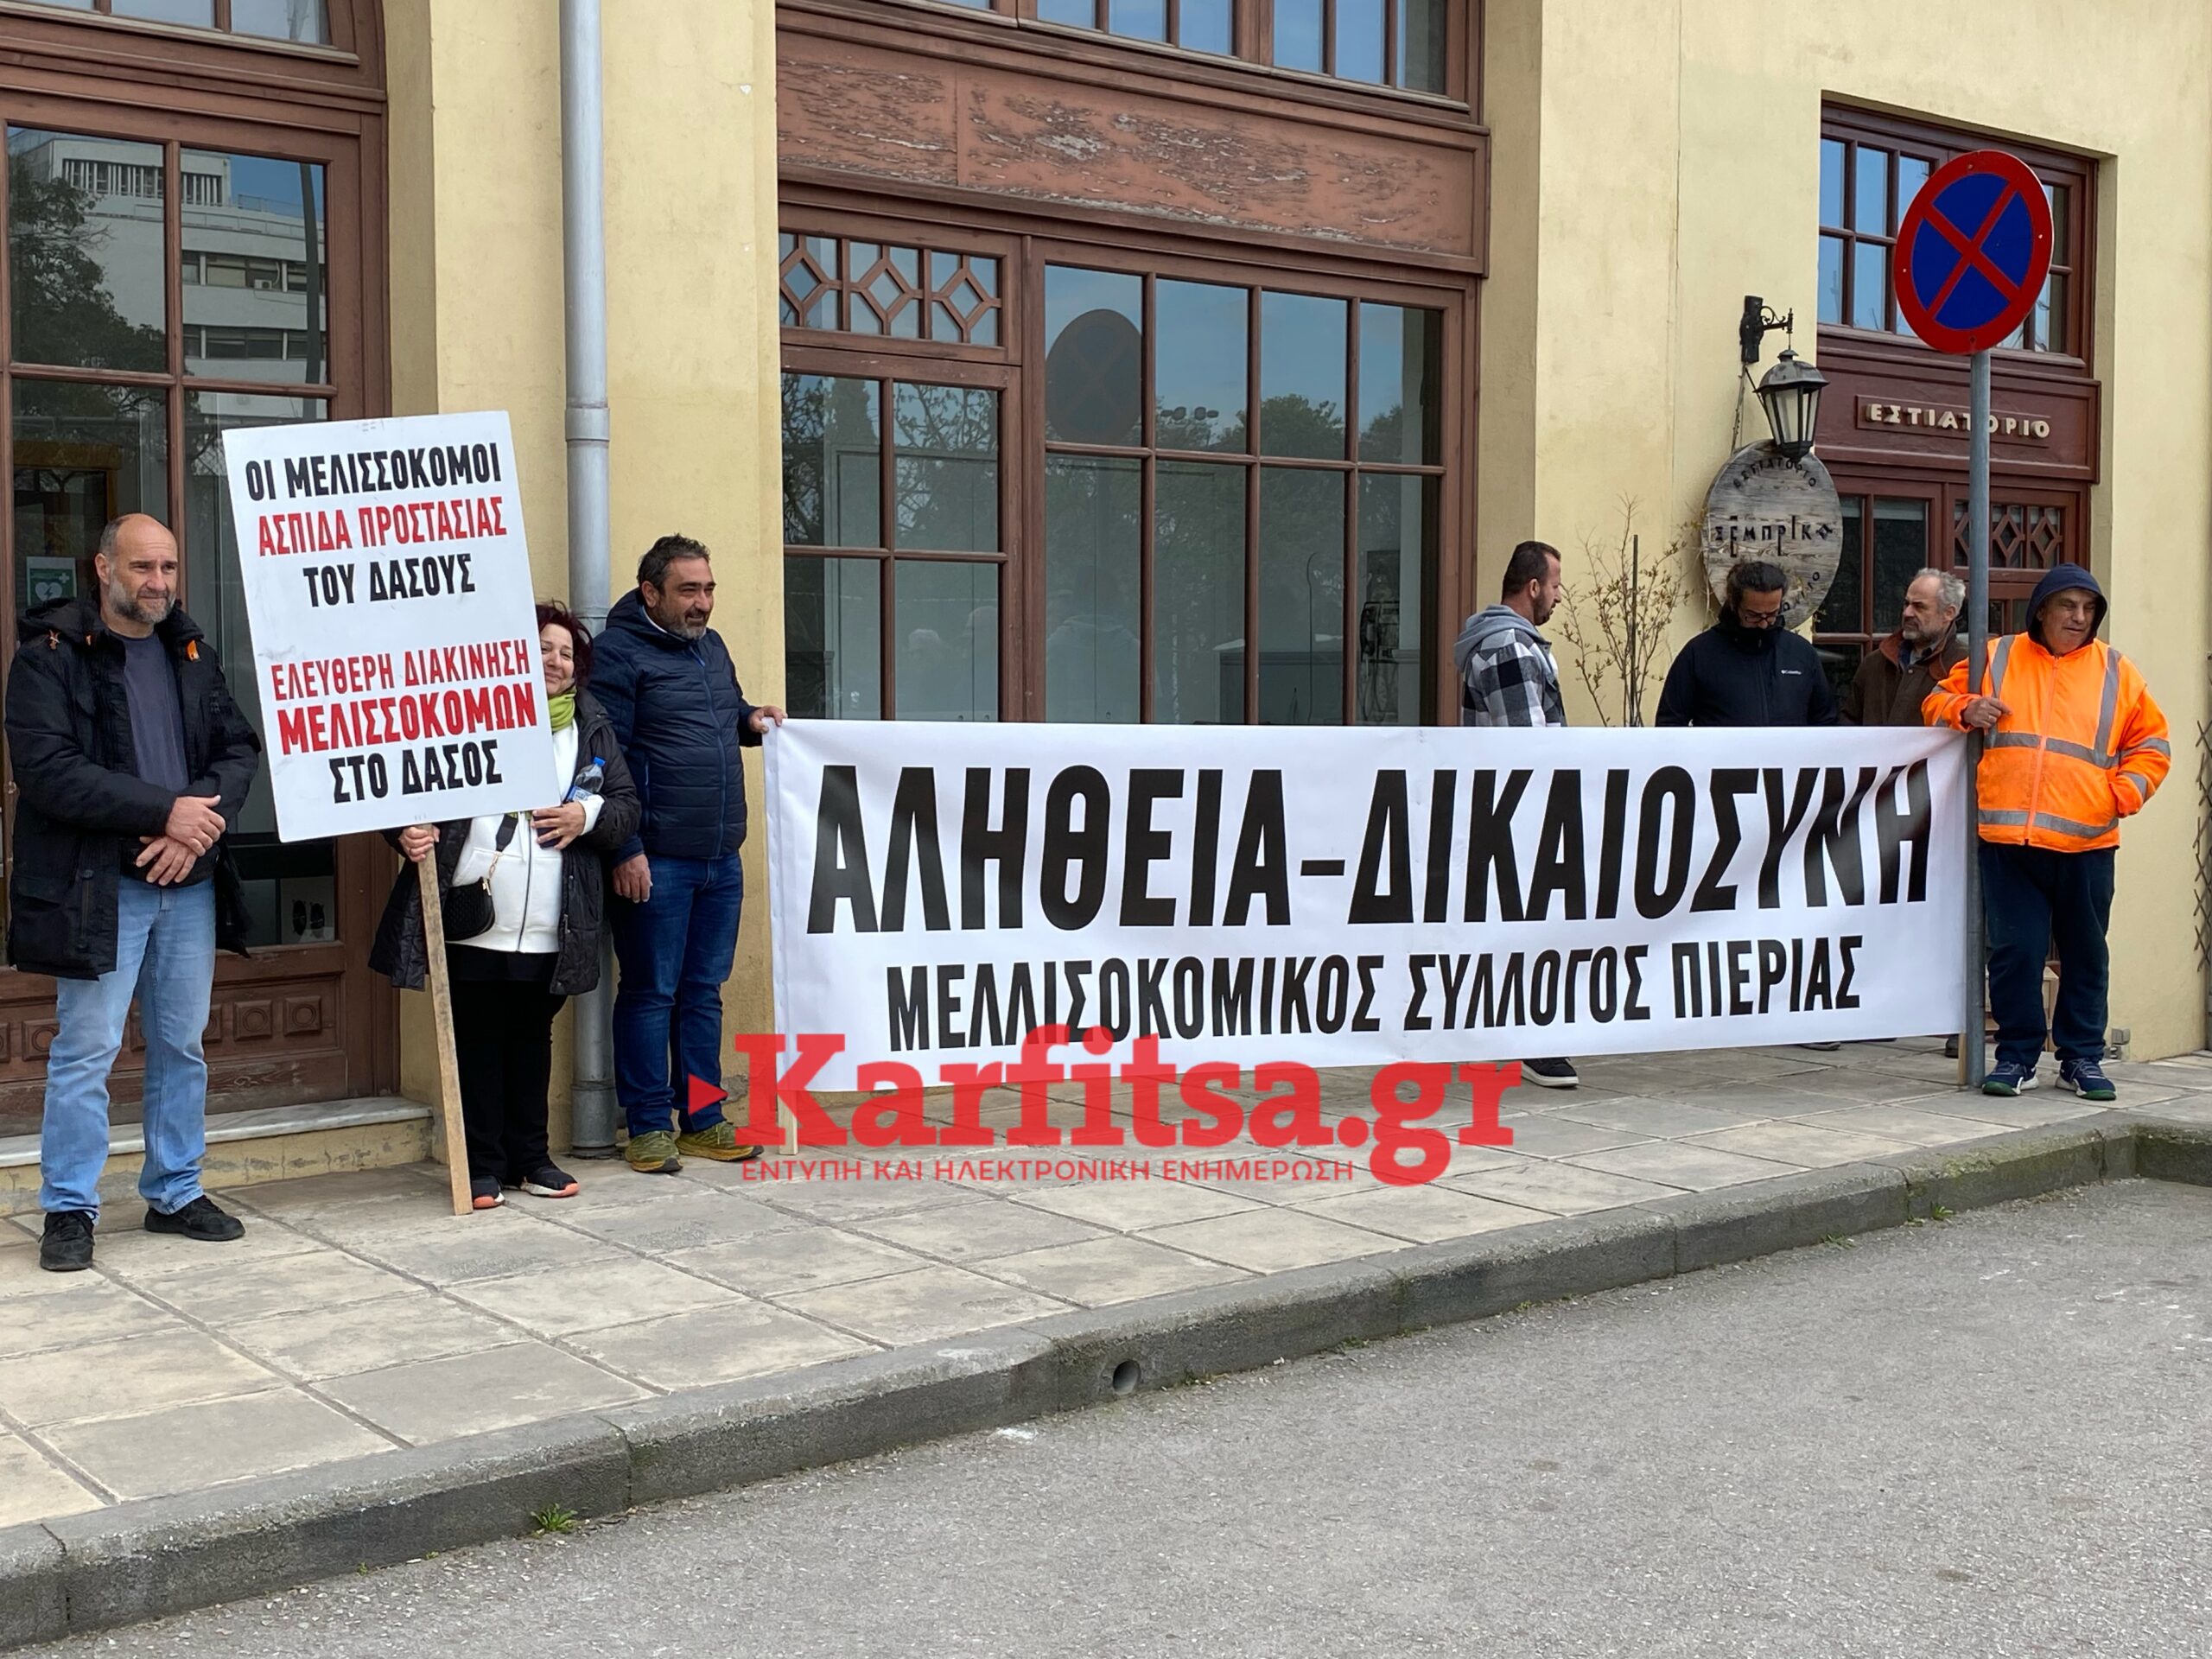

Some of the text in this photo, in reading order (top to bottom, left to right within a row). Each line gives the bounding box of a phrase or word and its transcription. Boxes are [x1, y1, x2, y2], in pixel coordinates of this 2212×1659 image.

[246, 442, 501, 501] ΟΙ ΜΕΛΙΣΣΟΚΟΜΟΙ
[258, 496, 506, 556] ΑΣΠΙΔΑ ΠΡΟΣΤΑΣΙΑΣ
[303, 553, 475, 607] ΤΟΥ ΔΑΣΟΥΣ
[270, 639, 531, 701] ΕΛΕΥΘΕΡΗ ΔΙΑΚΙΝΗΣΗ
[277, 682, 537, 755] ΜΕΛΙΣΣΟΚΟΜΩΝ
[329, 739, 503, 804] ΣΤΟ ΔΑΣΟΣ
[887, 935, 1863, 1052] ΜΕΛΛΙΣΟΚΟΜΙΚΟΣ ΣΥΛΛΟΓΟΣ ΠΙΕΡΙΑΣ
